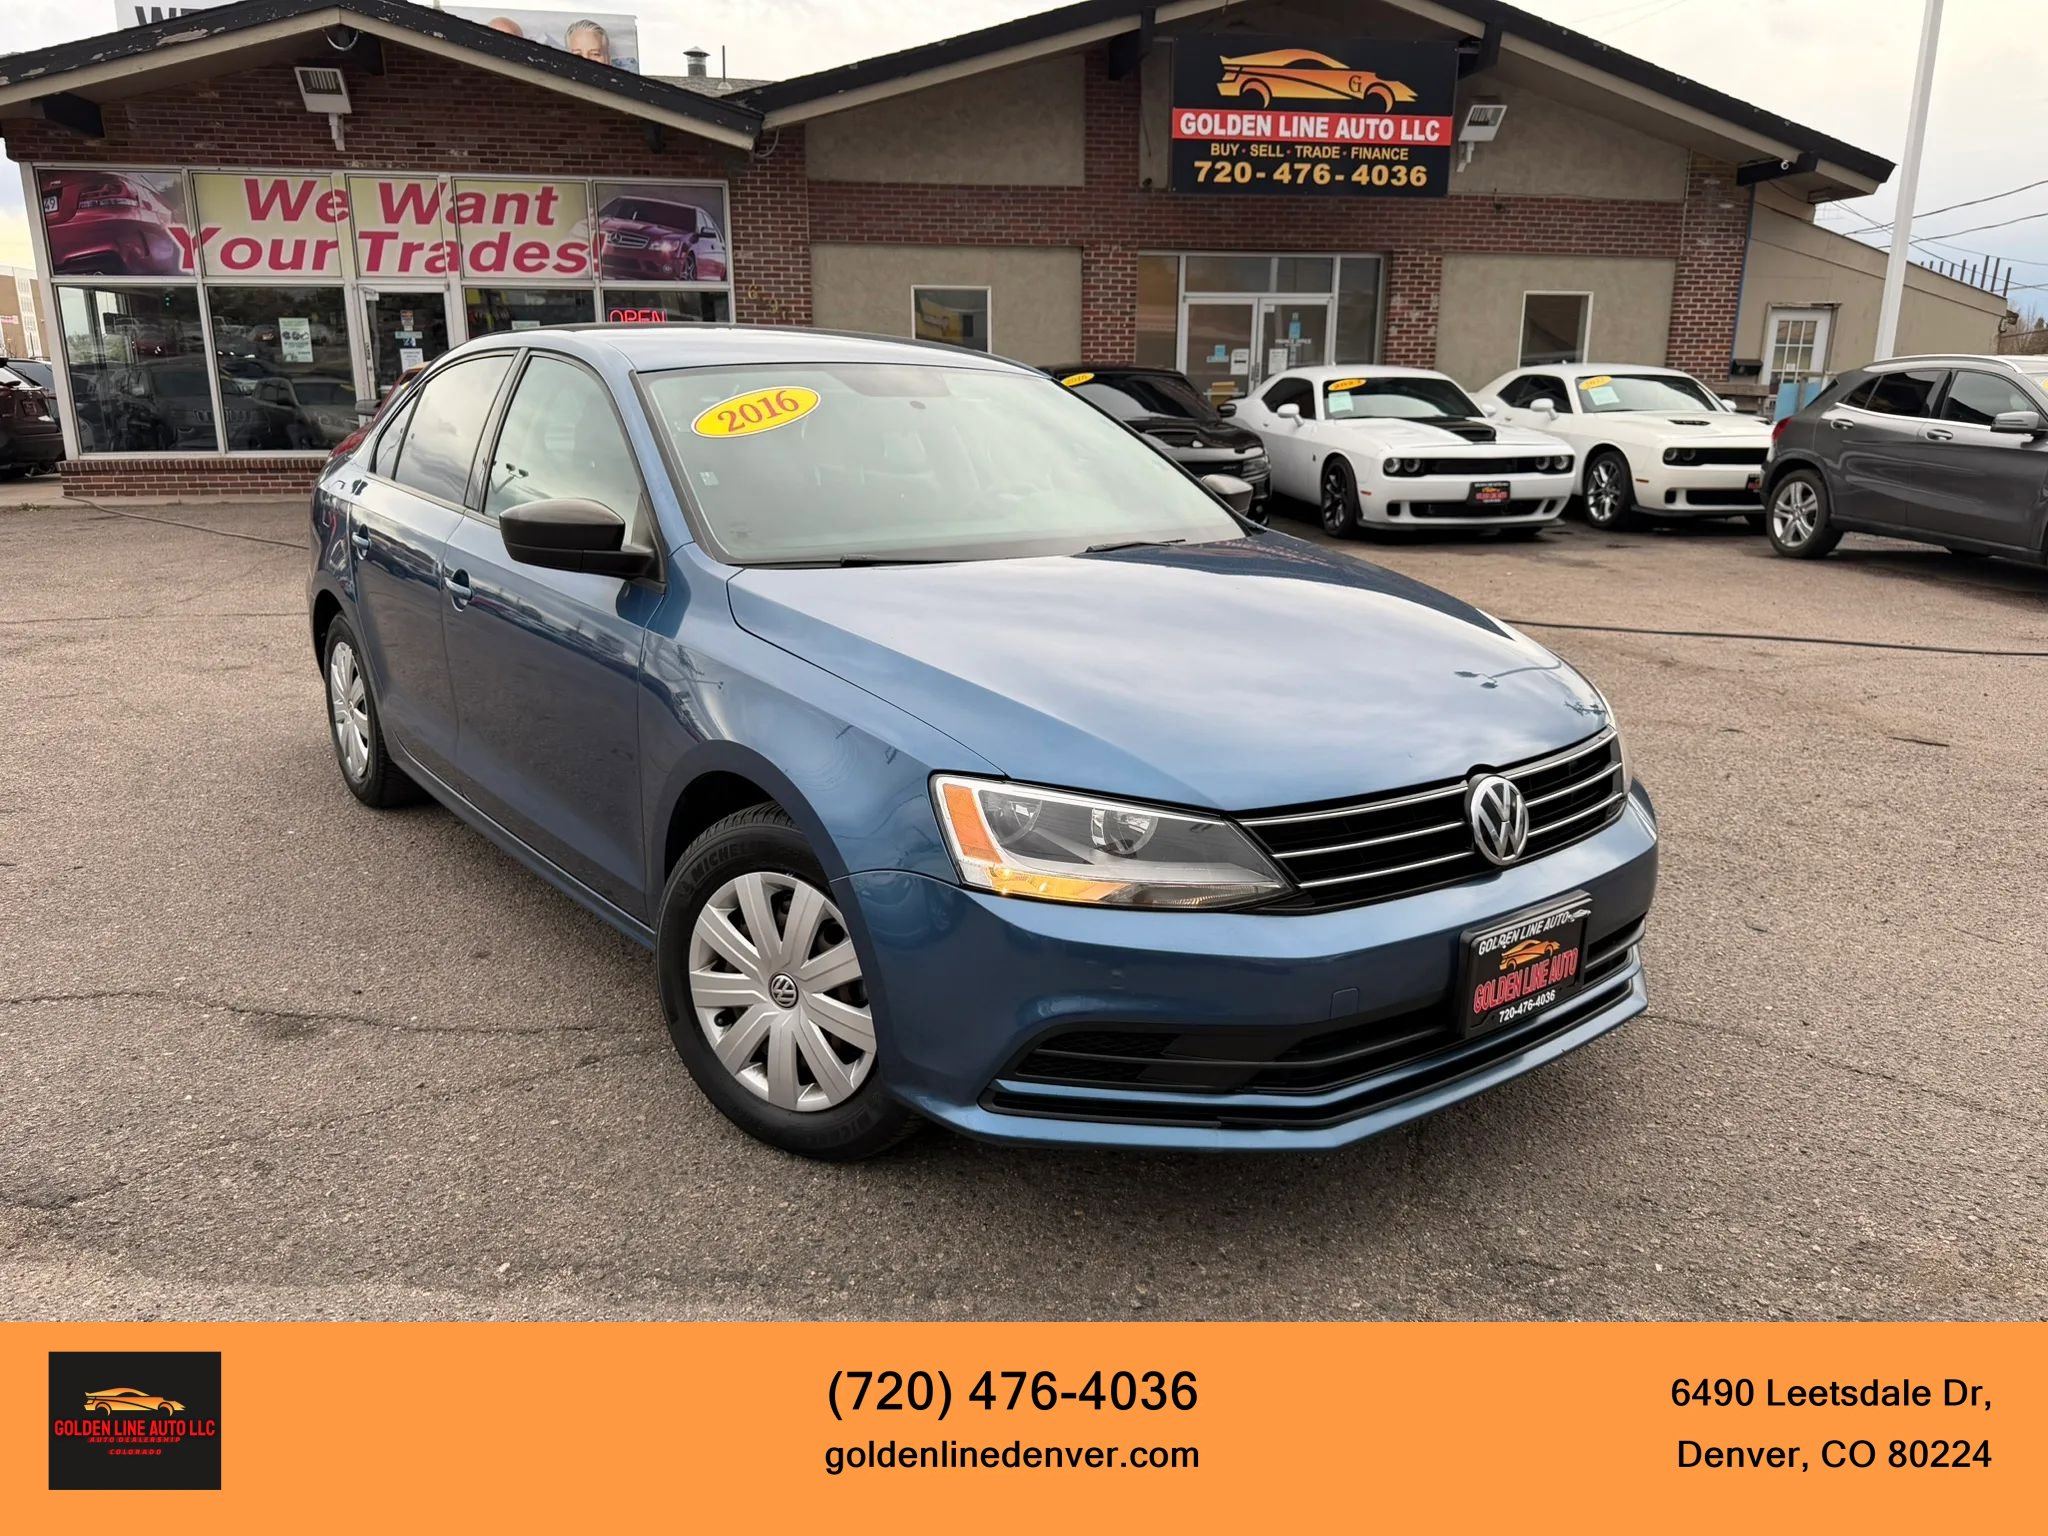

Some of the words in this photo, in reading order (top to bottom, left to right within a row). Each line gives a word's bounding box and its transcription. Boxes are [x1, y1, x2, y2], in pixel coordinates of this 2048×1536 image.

[1180, 112, 1272, 137] GOLDEN
[1279, 115, 1329, 138] LINE
[1335, 117, 1395, 140] AUTO
[1401, 119, 1440, 141] LLC
[1210, 143, 1239, 157] BUY
[1250, 144, 1284, 158] SELL
[1295, 145, 1340, 159] TRADE
[1351, 146, 1408, 160] FINANCE
[243, 178, 349, 224] We
[378, 182, 558, 226] Want
[168, 226, 339, 271] Your
[358, 231, 607, 274] Trades!
[609, 309, 666, 323] OPEN
[717, 390, 800, 432] 2016
[1520, 920, 1544, 940] LINE
[1543, 911, 1569, 931] AUTO
[1473, 969, 1524, 1014] GOLDEN
[1522, 959, 1550, 995] LINE
[1548, 947, 1579, 984] AUTO
[1499, 989, 1556, 1023] 720-476-4036
